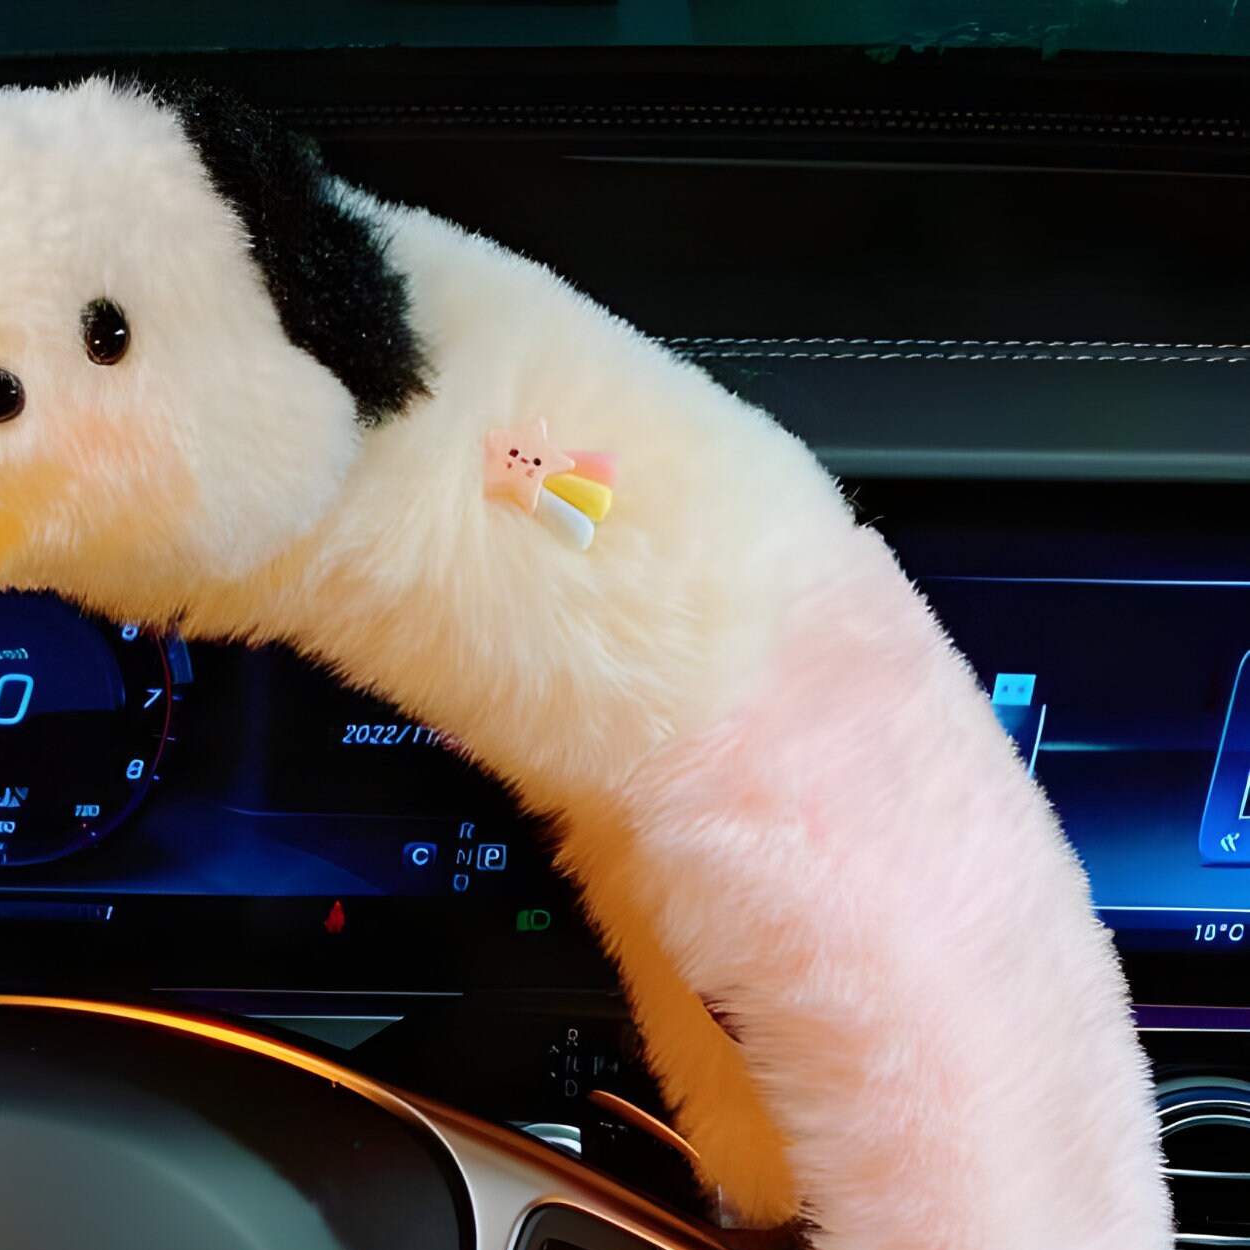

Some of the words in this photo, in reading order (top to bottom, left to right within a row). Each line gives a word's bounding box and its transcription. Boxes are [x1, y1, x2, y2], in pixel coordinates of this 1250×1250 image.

[143, 688, 163, 708] 7
[125, 759, 145, 780] 8
[411, 847, 430, 866] C
